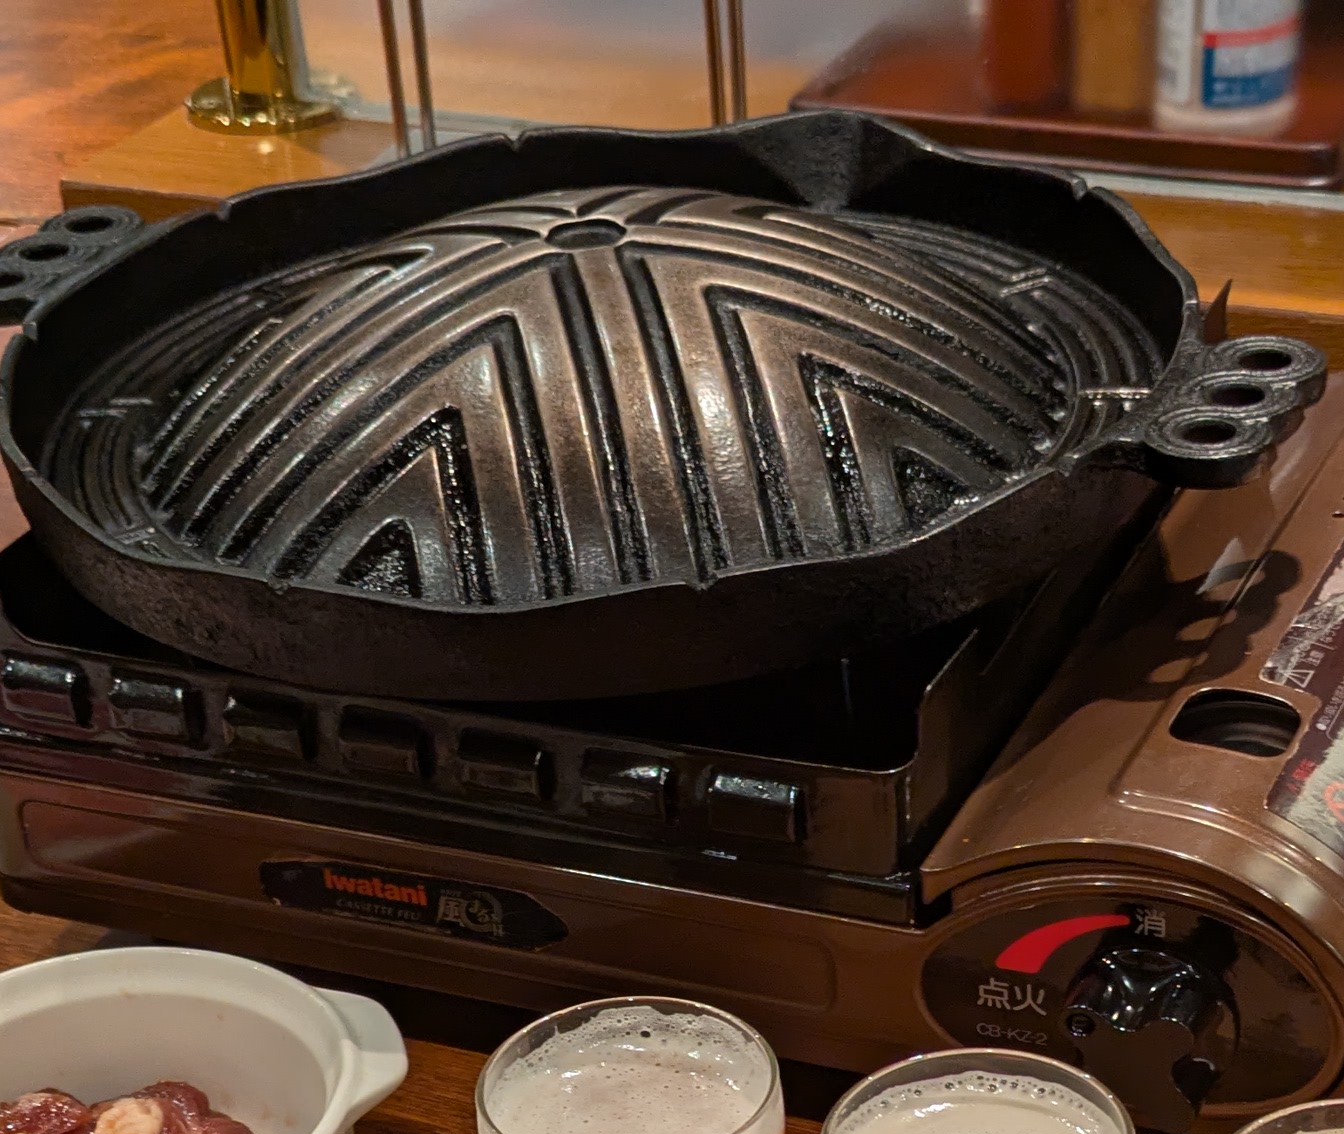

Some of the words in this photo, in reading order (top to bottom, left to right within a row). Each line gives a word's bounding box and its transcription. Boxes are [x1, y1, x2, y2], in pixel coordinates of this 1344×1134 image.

[322, 867, 428, 907] Iwatani
[1133, 907, 1167, 939] 消
[976, 976, 1048, 1017] 点火
